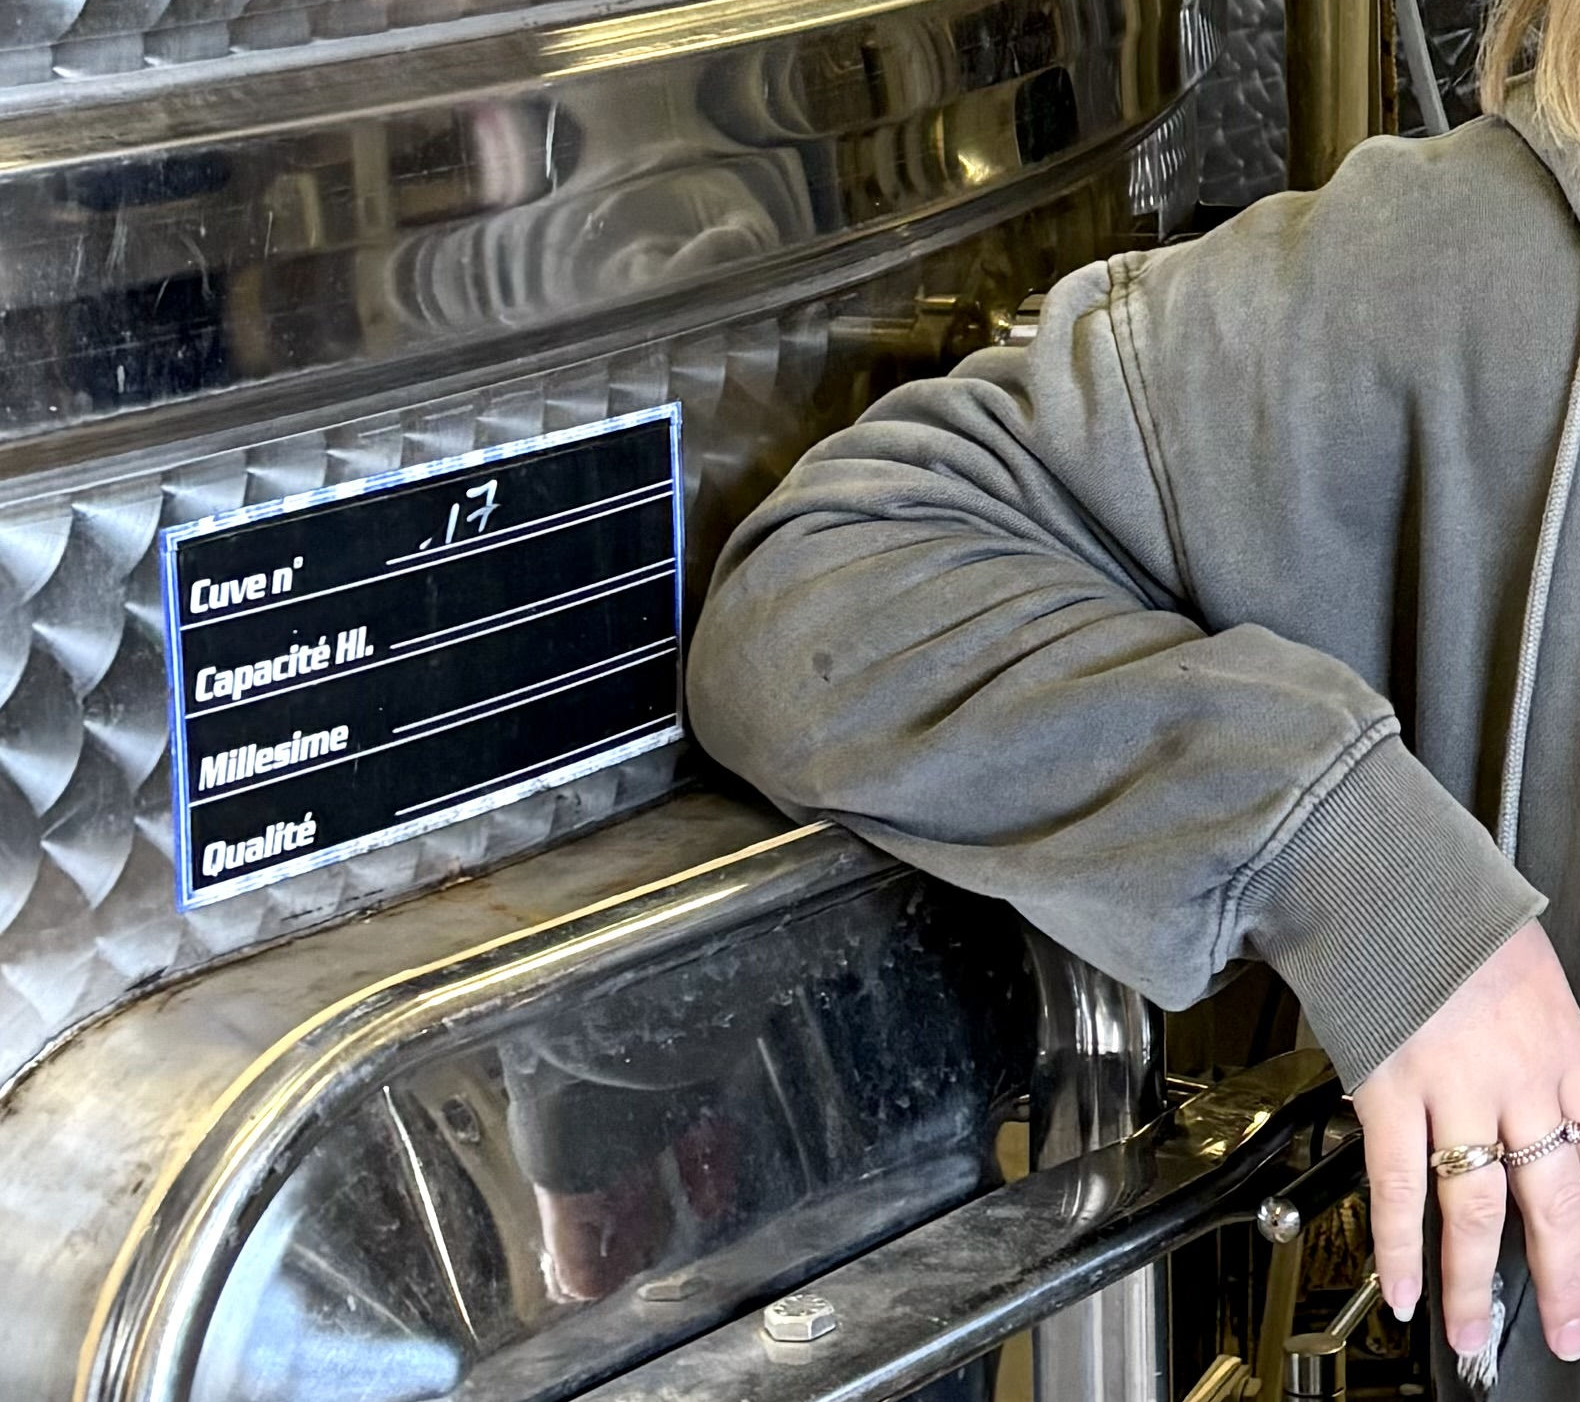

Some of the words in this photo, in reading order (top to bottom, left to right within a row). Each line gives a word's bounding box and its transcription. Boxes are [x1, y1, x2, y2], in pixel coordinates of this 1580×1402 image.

[189, 576, 268, 614] Cuve
[271, 555, 304, 596] n°
[194, 634, 331, 703] Capacité
[334, 625, 375, 666] Hl.
[197, 723, 350, 792] Millesime
[201, 811, 317, 878] Qualité
